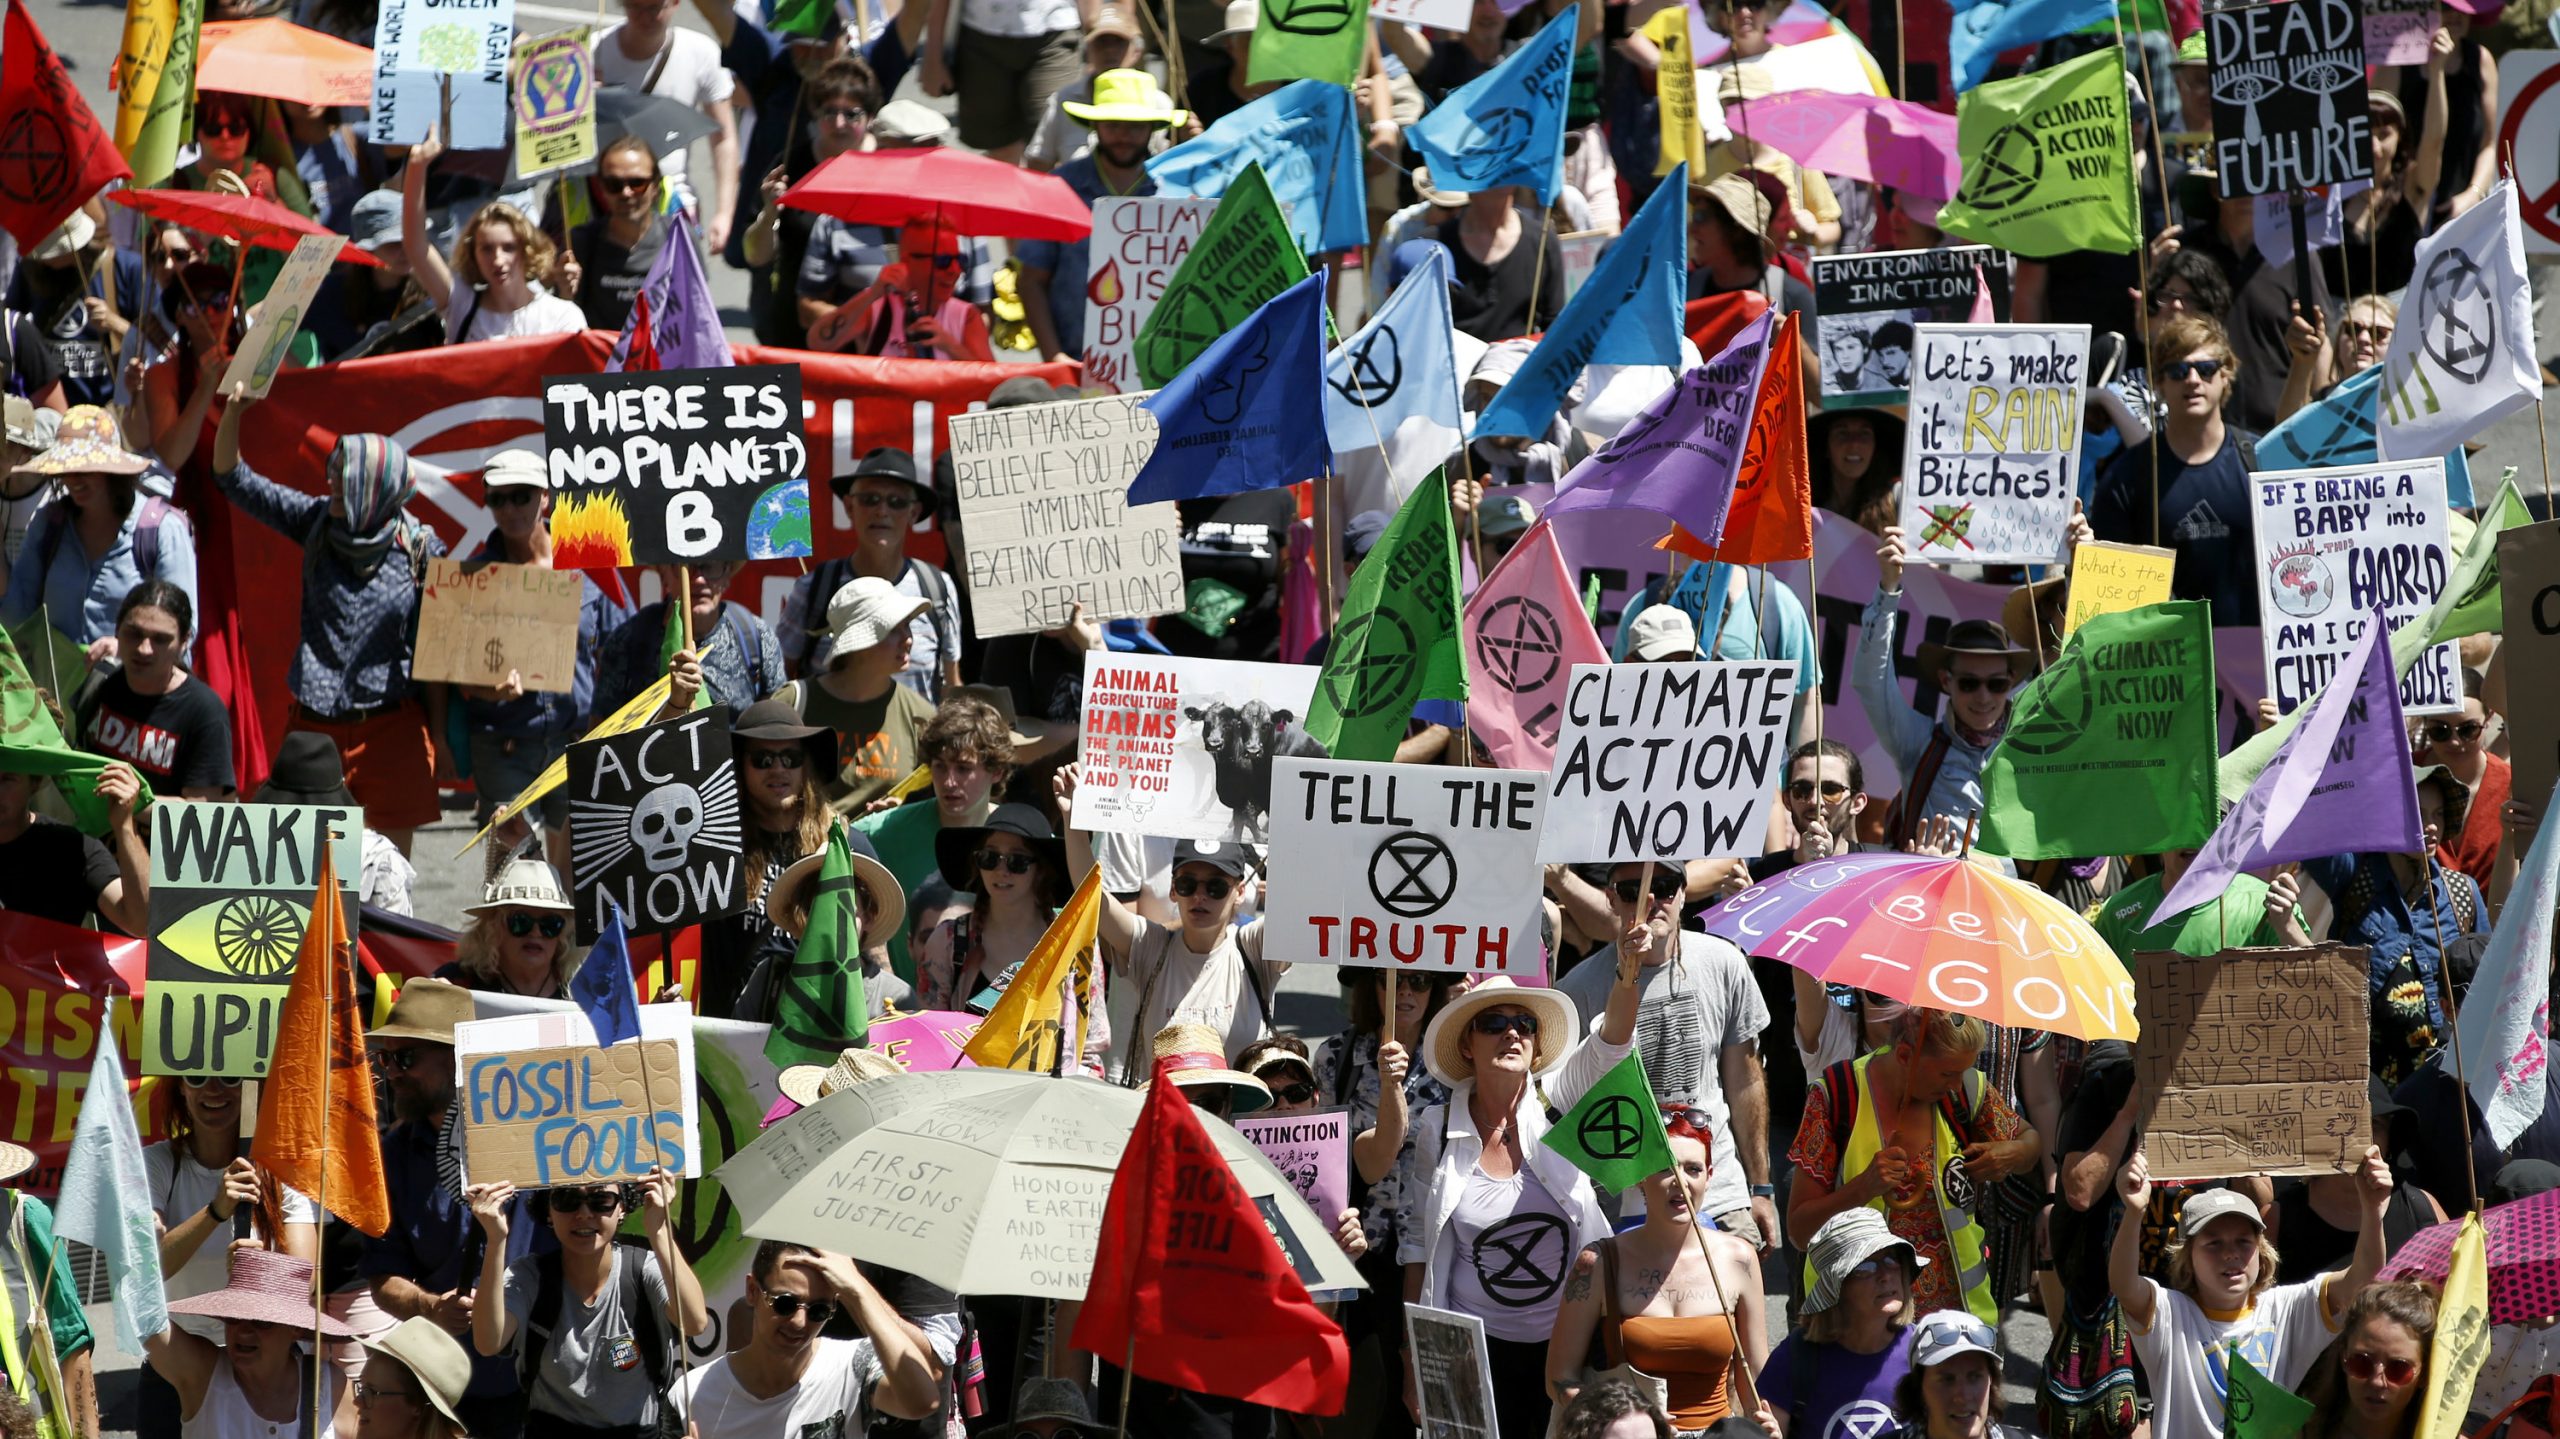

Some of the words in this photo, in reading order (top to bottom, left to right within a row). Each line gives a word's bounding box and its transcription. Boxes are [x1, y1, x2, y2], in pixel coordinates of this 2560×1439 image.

[382, 0, 404, 44] WORL
[2211, 0, 2353, 66] DEAD
[380, 49, 398, 79] THE
[484, 22, 508, 84] AGAIN
[1545, 80, 1567, 110] FO
[377, 88, 396, 142] MAKE
[2033, 96, 2115, 129] CLIMATE
[2048, 125, 2116, 157] ACTION
[2218, 115, 2373, 197] FUTURE
[2066, 155, 2111, 180] NOW
[1112, 201, 1214, 234] CLIM
[1122, 233, 1194, 266] CHA
[1200, 207, 1269, 282] CLIMATE
[1214, 235, 1280, 305] ACTION
[1818, 249, 2006, 285] ENVIRONMENTAL
[1242, 267, 1290, 313] NOW
[1848, 276, 1977, 304] INACTION.
[1697, 362, 1750, 385] ENDS
[1925, 339, 1994, 382] Let's
[2009, 340, 2078, 384] make
[547, 384, 708, 435] THERE
[723, 384, 788, 429] IS
[1693, 386, 1747, 417] TACTI
[950, 411, 1013, 455] WHAT
[1027, 401, 1112, 446] MAKES
[1704, 416, 1739, 448] BEGI
[1922, 402, 1946, 450] it
[1963, 385, 2077, 453] RAIN
[549, 444, 622, 489] NO
[623, 431, 806, 489] PLAN(ET)
[957, 451, 1056, 500] BELIEVE
[1065, 445, 1111, 485] YOU
[1918, 456, 2067, 499] Bitches!
[2263, 485, 2286, 506] IF
[2294, 483, 2306, 503] I
[2315, 476, 2385, 503] BRING
[2396, 475, 2414, 496] A
[665, 490, 723, 558] B
[1020, 487, 1126, 538] IMMUNE?
[2294, 503, 2371, 537] BABY
[2387, 503, 2426, 528] into
[970, 535, 1121, 588] EXTINCTION
[1141, 527, 1174, 567] OR
[2324, 538, 2354, 553] THIS
[2080, 552, 2127, 579] What's
[2136, 564, 2166, 583] the
[2349, 544, 2447, 610] WORLD
[1022, 571, 1181, 627] REBELLION?
[2096, 584, 2123, 599] use
[2127, 586, 2146, 606] of
[2277, 623, 2315, 650] AM
[2325, 622, 2337, 644] I
[484, 636, 504, 673] $
[2093, 638, 2187, 671] CLIMATE
[1092, 668, 1179, 694] ANIMAL
[1569, 667, 1794, 729] CLIMATE
[2099, 674, 2184, 706] ACTION
[1089, 692, 1177, 711] AGRICULTURE
[86, 708, 177, 769] ADANI
[1086, 709, 1177, 740] HARMS
[2117, 710, 2174, 740] NOW
[591, 716, 710, 800] ACT
[1085, 752, 1110, 768] THE
[1118, 754, 1172, 773] PLANET
[1086, 736, 1108, 751] THE
[1116, 738, 1174, 755] ANIMALS
[1553, 731, 1774, 797] ACTION
[2032, 762, 2044, 774] THE
[1084, 770, 1119, 788] AND
[1129, 774, 1169, 793] YOU!
[1299, 771, 1413, 827] TELL
[1442, 780, 1536, 831] THE
[1608, 799, 1755, 858] NOW
[158, 804, 348, 888] WAKE
[596, 855, 735, 934] NOW
[2115, 901, 2142, 920] sport
[1308, 916, 1509, 970] TRUTH
[2148, 960, 2201, 990] LET
[2219, 959, 2242, 989] IT
[2255, 956, 2334, 990] GROW
[2151, 992, 2203, 1020] LET
[2219, 994, 2239, 1022] IT
[2257, 992, 2339, 1022] GROW
[159, 992, 286, 1072] UP!
[2153, 1022, 2201, 1051] IT'S
[2207, 1024, 2276, 1054] JUST
[2285, 1025, 2347, 1059] ONE
[2148, 1056, 2224, 1086] TINY
[2323, 1063, 2370, 1085] BUT
[469, 1055, 623, 1124] FOSSIL
[2153, 1091, 2197, 1120] IT'S
[2204, 1093, 2248, 1117] ALL
[2257, 1089, 2293, 1114] WE
[2302, 1086, 2368, 1112] REALLY
[914, 1119, 996, 1143] NOW
[1243, 1121, 1339, 1146] EXTINCTION
[2251, 1130, 2273, 1142] LET
[2277, 1129, 2290, 1140] IT
[2252, 1117, 2268, 1128] WE
[2274, 1116, 2297, 1128] SAY
[534, 1110, 685, 1185] FOOLS
[1032, 1134, 1120, 1157] FACTS
[2158, 1123, 2241, 1168] NEED
[2251, 1140, 2299, 1161] GROW!
[853, 1150, 953, 1183] FIRST
[827, 1171, 962, 1213] NATIONS
[813, 1197, 935, 1239] JUSTICE
[1026, 1200, 1103, 1219] EARTH
[1006, 1220, 1046, 1236] AND
[1020, 1245, 1093, 1264] ANCES
[1030, 1270, 1091, 1289] OWNE
